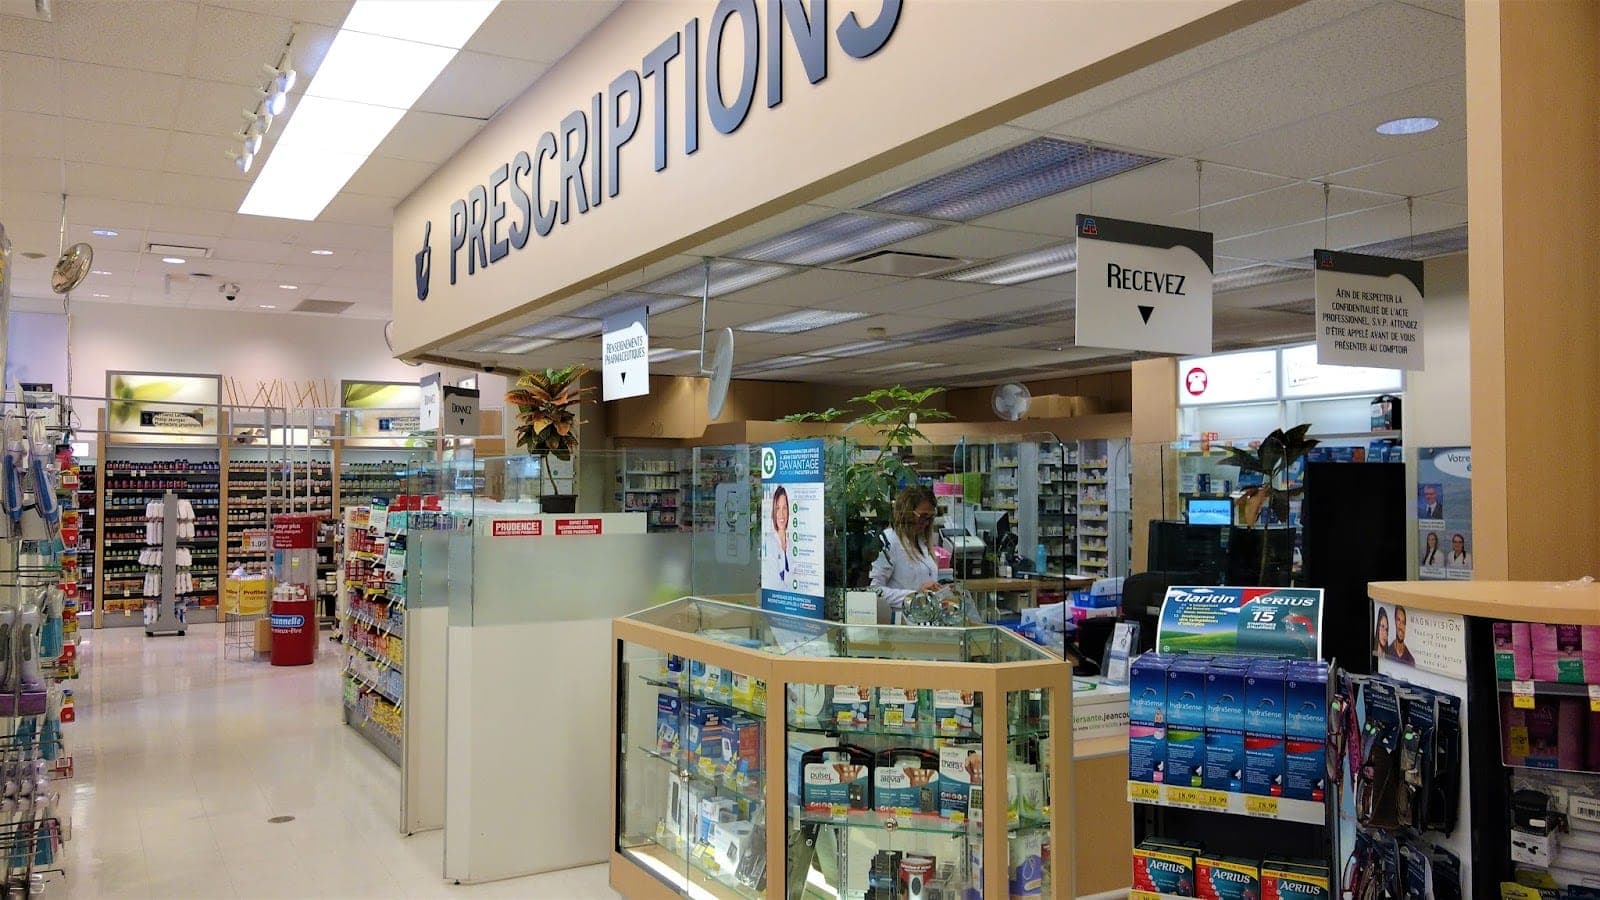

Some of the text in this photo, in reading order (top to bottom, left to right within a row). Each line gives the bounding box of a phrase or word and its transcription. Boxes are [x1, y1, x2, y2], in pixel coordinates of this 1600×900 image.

[1107, 263, 1186, 296] RECEVEZ
[1336, 288, 1403, 303] AFIN DE RESPECTER LA
[1332, 302, 1408, 317] CONFIDENTIALITÉ DE L'ACTE
[1390, 320, 1418, 330] ATTENDEZ
[1326, 326, 1416, 342] D'ÊTRE APPELÉ AVANT DE VOUS
[606, 336, 643, 354] RENSEIGNEMENTS
[1335, 341, 1408, 354] PRÉSENTER AU COMPTOIR
[605, 347, 646, 365] PHARMACEUTIQUES
[452, 403, 472, 415] DONNEZ
[1447, 454, 1470, 463] Votre
[780, 459, 819, 470] DAVANTAGE
[496, 522, 540, 531] PRUDENCE!
[251, 540, 266, 548] 1.99
[1174, 594, 1235, 604] Claritin
[1252, 611, 1275, 622] 15
[1132, 699, 1162, 708] hydraSense
[1170, 702, 1202, 712] hydraSense
[1208, 705, 1242, 715] hydraSense
[1248, 709, 1282, 719] hydraSense
[1289, 712, 1324, 722] hydraSense
[1141, 788, 1158, 796] 18.99
[1178, 792, 1196, 800] 18.99
[1208, 796, 1227, 804] 18.99
[1258, 802, 1277, 810] 18.99
